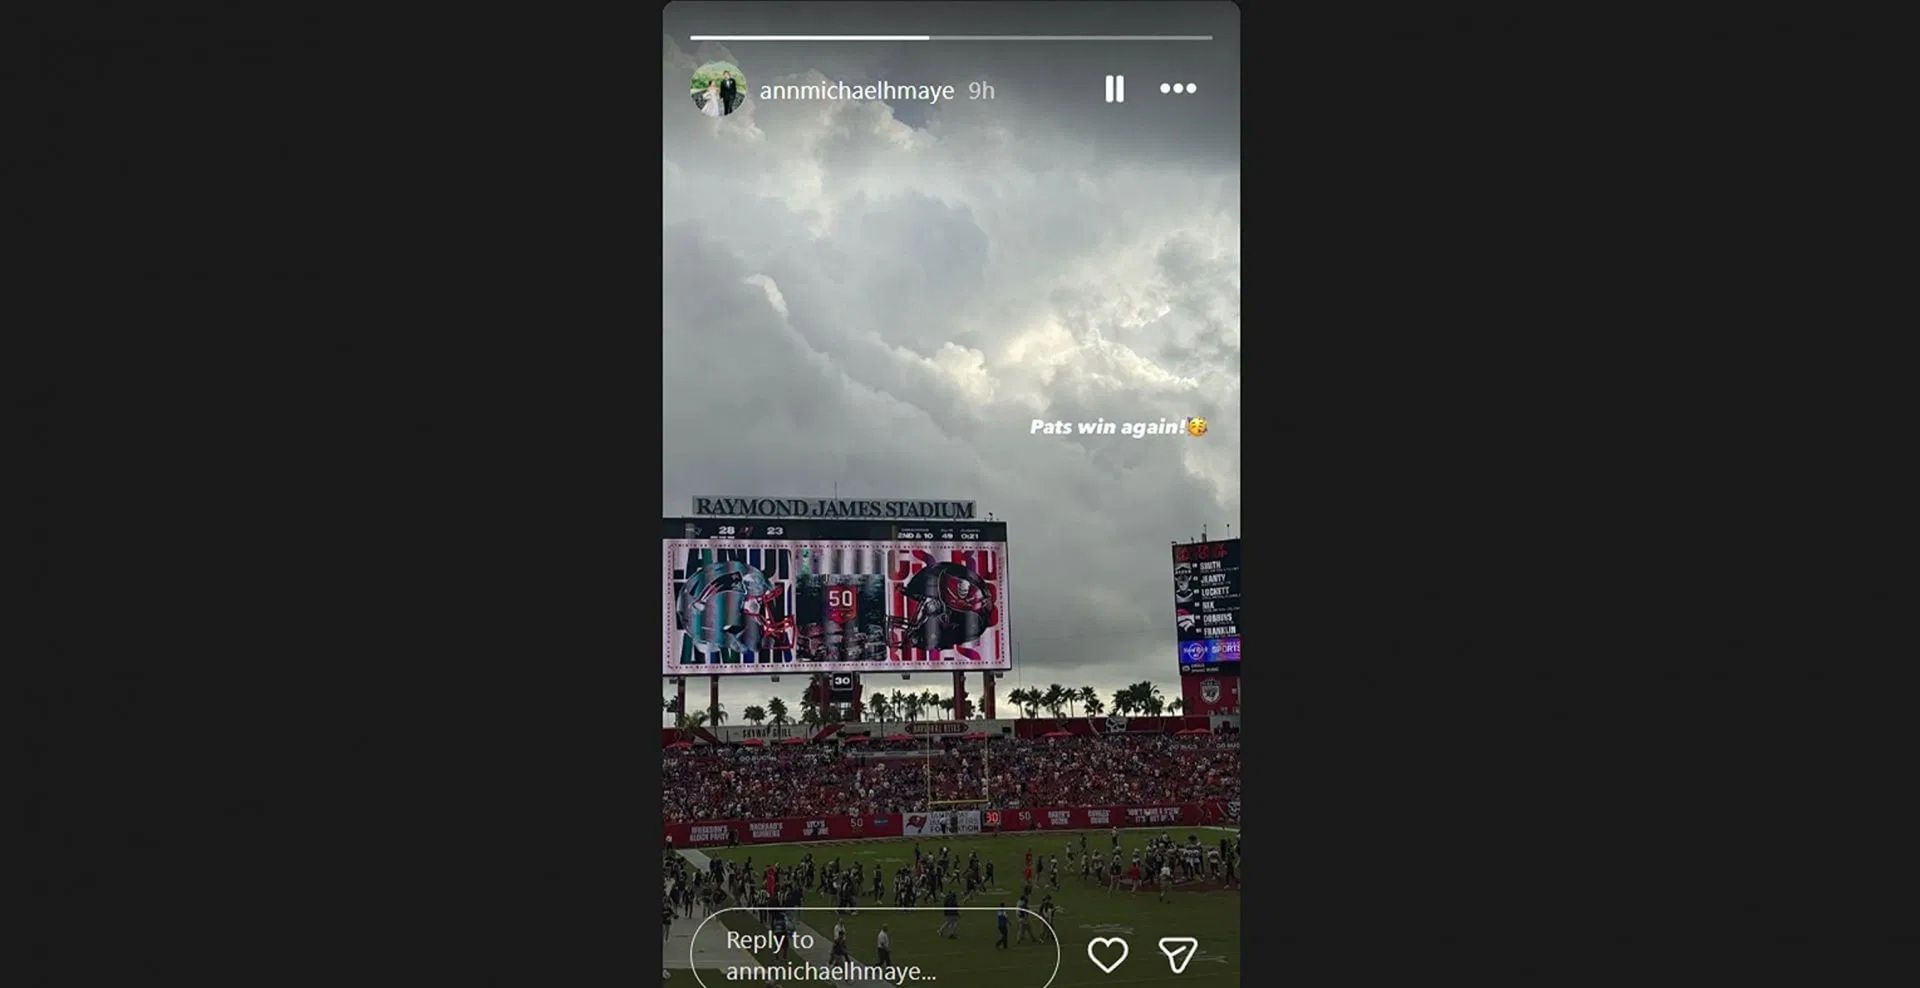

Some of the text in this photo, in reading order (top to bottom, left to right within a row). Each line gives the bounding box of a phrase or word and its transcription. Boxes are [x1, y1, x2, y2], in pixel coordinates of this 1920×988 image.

[697, 498, 975, 519] RAYMOND JAMES STADIUM
[718, 526, 736, 535] 28
[767, 526, 785, 535] 23
[829, 590, 853, 607] 50
[834, 676, 851, 685] 30
[986, 812, 999, 823] 30
[1019, 811, 1032, 821] 50
[851, 818, 864, 828] 50
